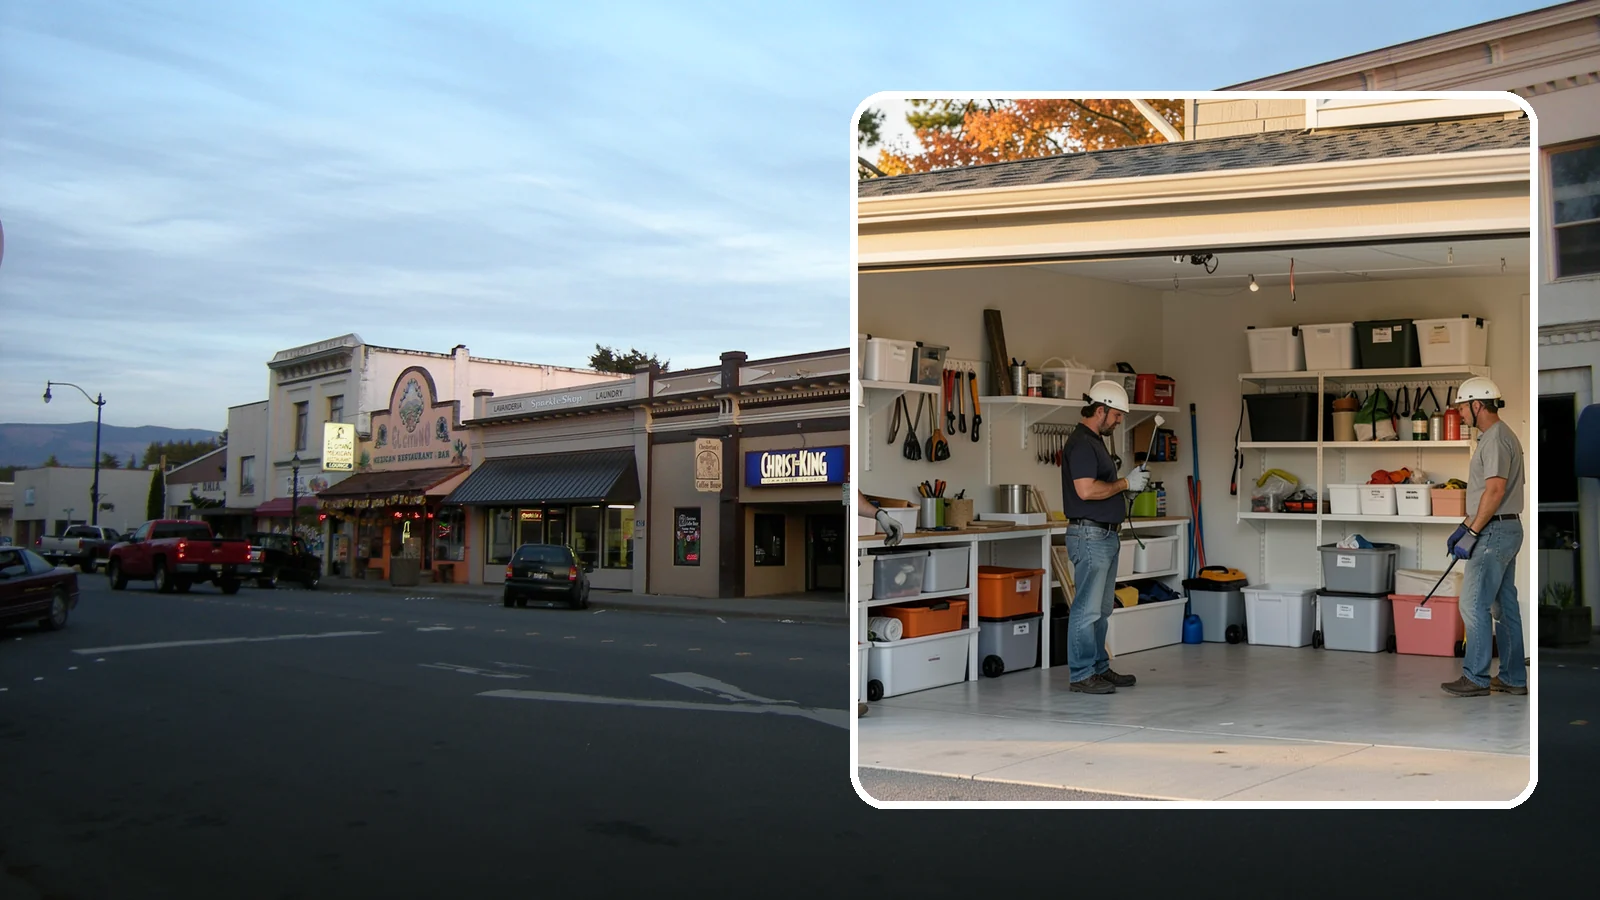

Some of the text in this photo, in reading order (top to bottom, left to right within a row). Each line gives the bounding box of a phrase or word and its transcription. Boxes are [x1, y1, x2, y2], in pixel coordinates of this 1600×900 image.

[493, 402, 522, 412] LAVANDERIA
[562, 394, 582, 405] Shop
[595, 389, 623, 400] LAUNDRY
[374, 455, 396, 464] MEXICAN
[397, 451, 433, 462] RESTAURANT
[438, 450, 450, 459] BAR
[761, 450, 827, 477] CHRIST KING
